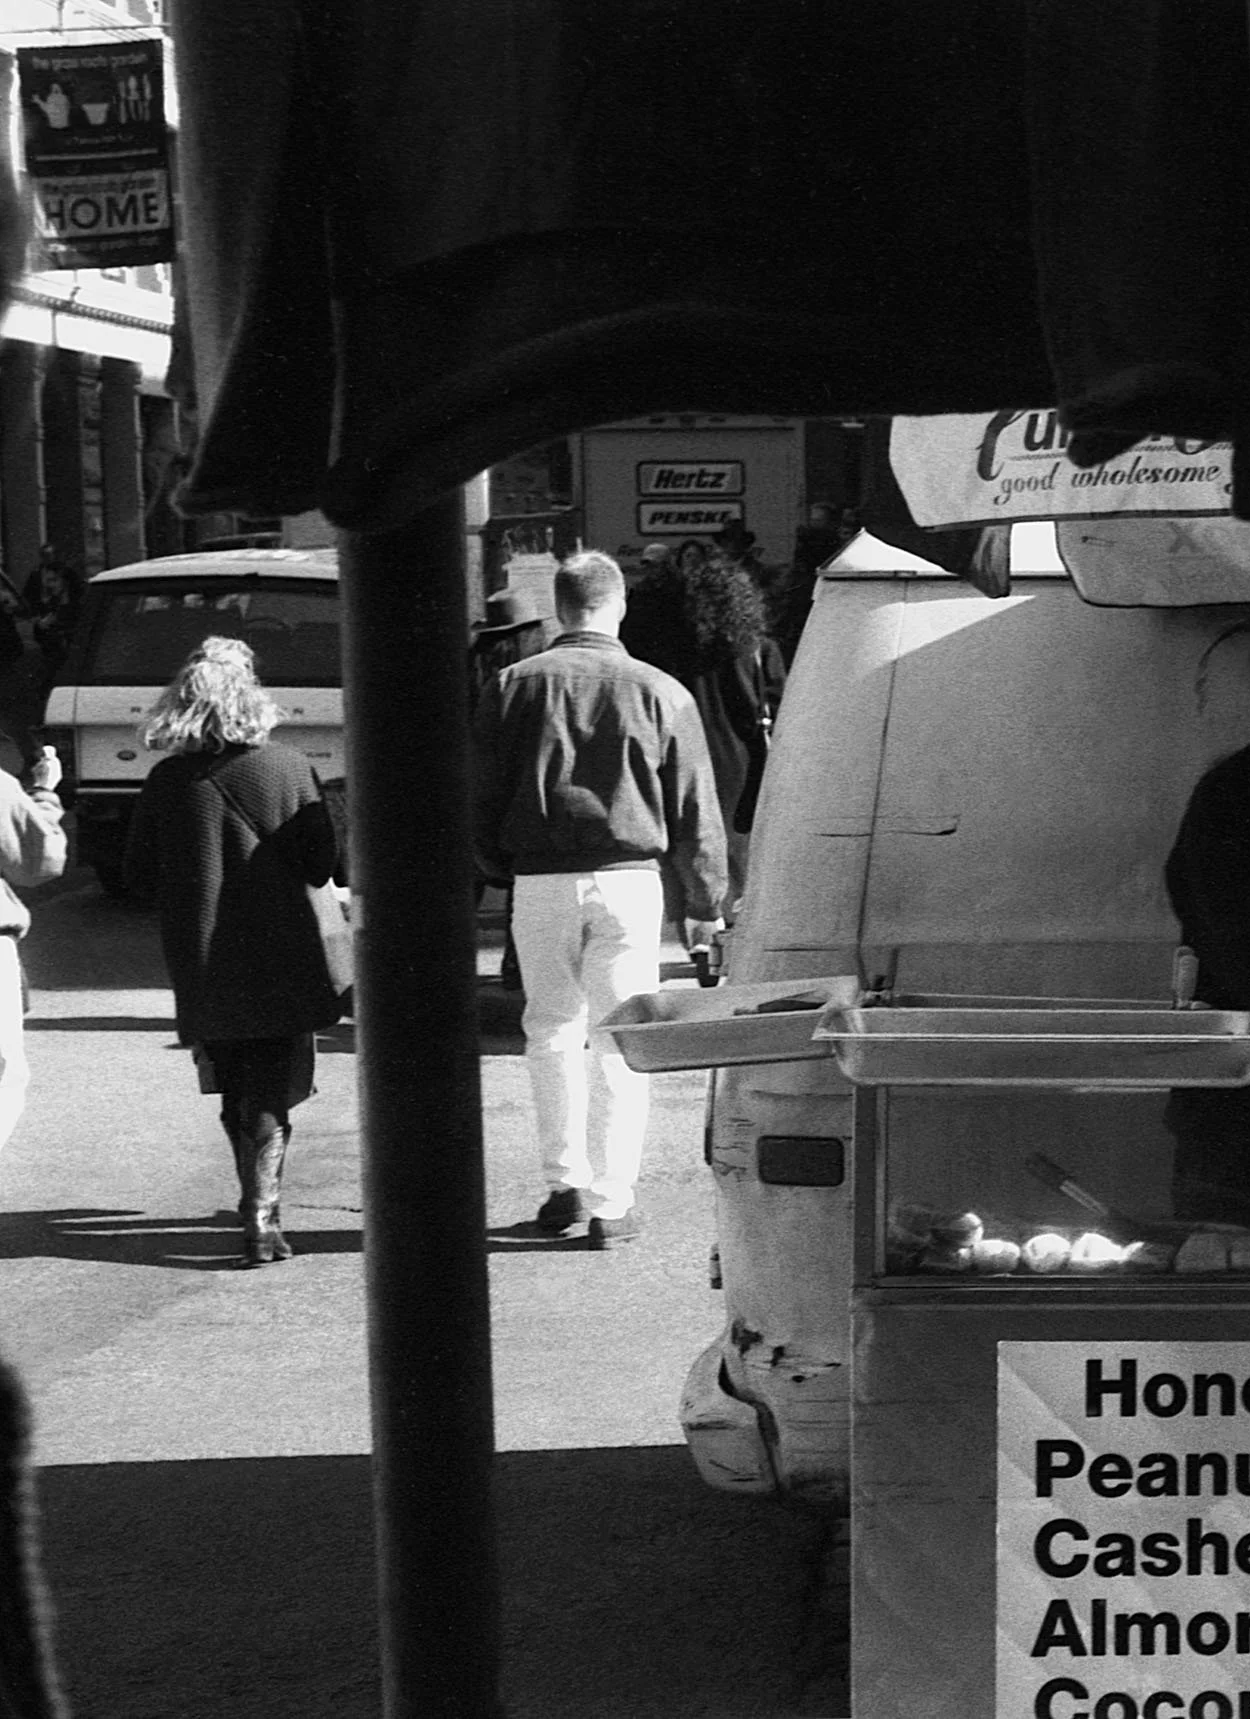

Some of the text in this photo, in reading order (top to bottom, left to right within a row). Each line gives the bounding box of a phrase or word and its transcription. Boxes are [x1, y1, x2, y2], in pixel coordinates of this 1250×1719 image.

[45, 192, 159, 231] HOME
[653, 468, 727, 489] Hertz
[992, 456, 1221, 505] good wholesome
